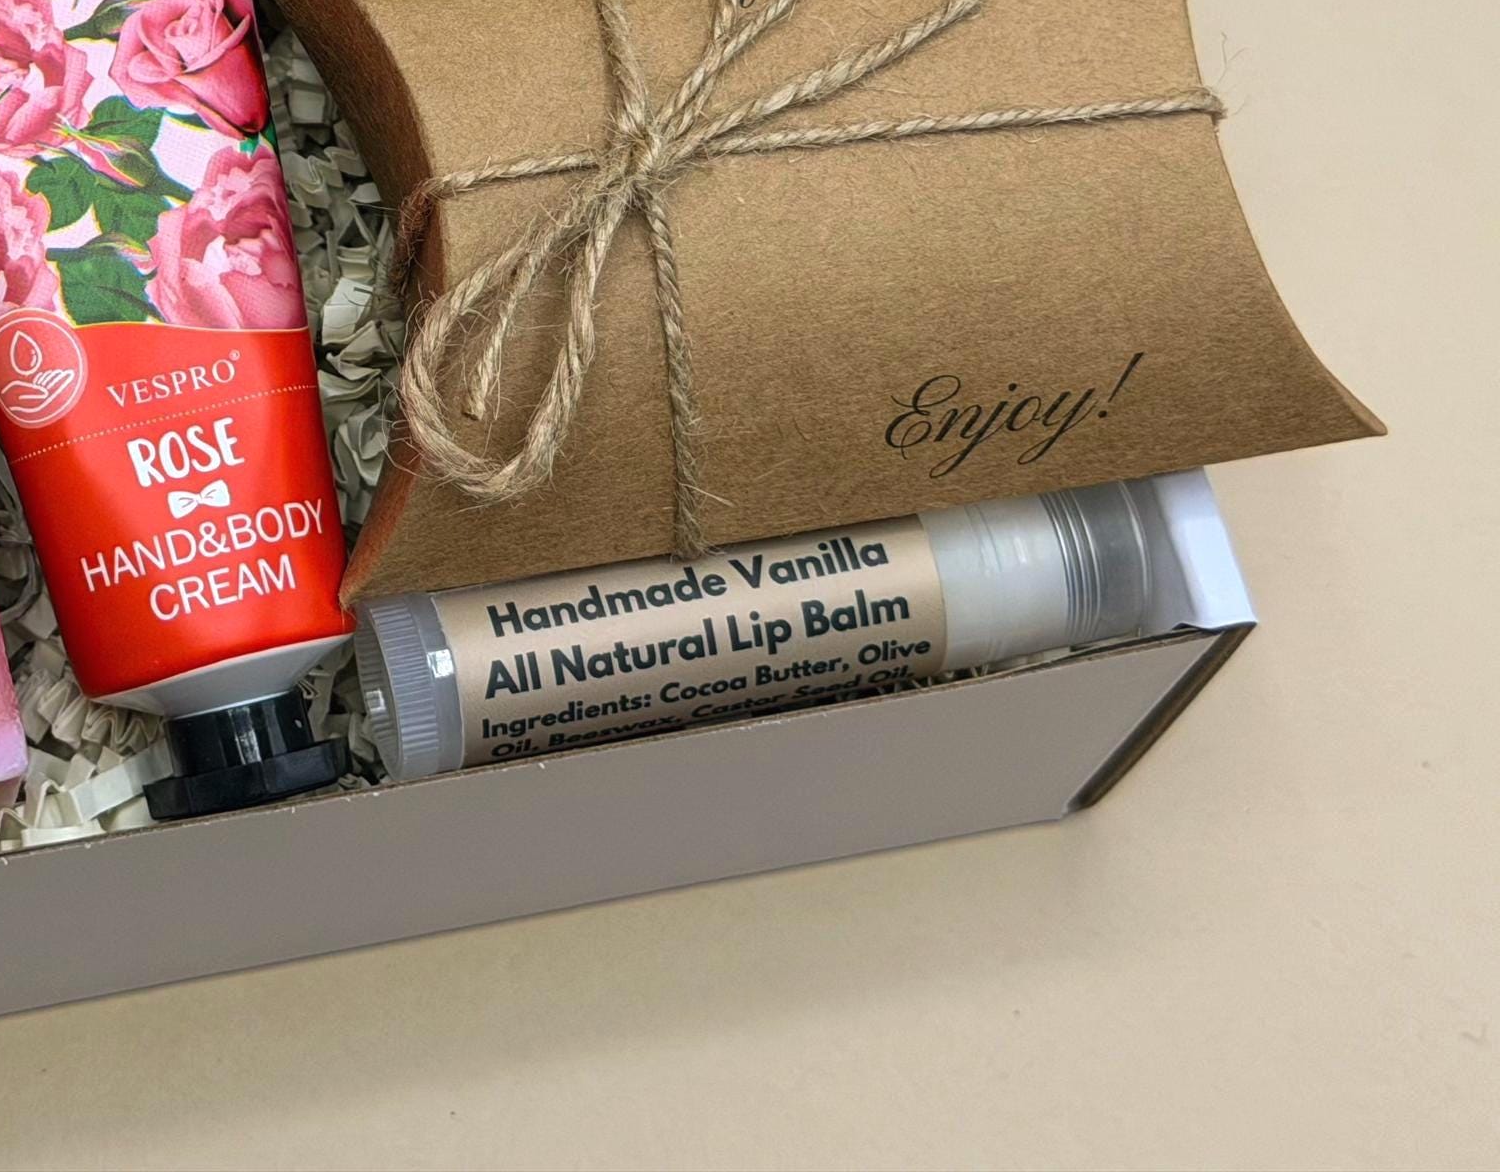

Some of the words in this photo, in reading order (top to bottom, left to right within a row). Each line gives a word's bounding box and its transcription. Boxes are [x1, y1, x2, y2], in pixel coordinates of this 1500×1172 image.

[126, 416, 245, 488] ROSE
[884, 352, 1145, 478] Enjoy!
[80, 498, 324, 593] HAND&BODY
[150, 553, 297, 621] CREAM
[485, 566, 728, 638] Handmade
[727, 536, 890, 589] Vanilla
[482, 692, 652, 739] Ingredients:
[659, 675, 748, 704] Cocoa
[755, 656, 850, 687] Butter,
[858, 640, 931, 666] Olive
[484, 651, 542, 699] All
[550, 617, 718, 686] Natural
[727, 610, 793, 656] Lip
[801, 588, 911, 638] Balm
